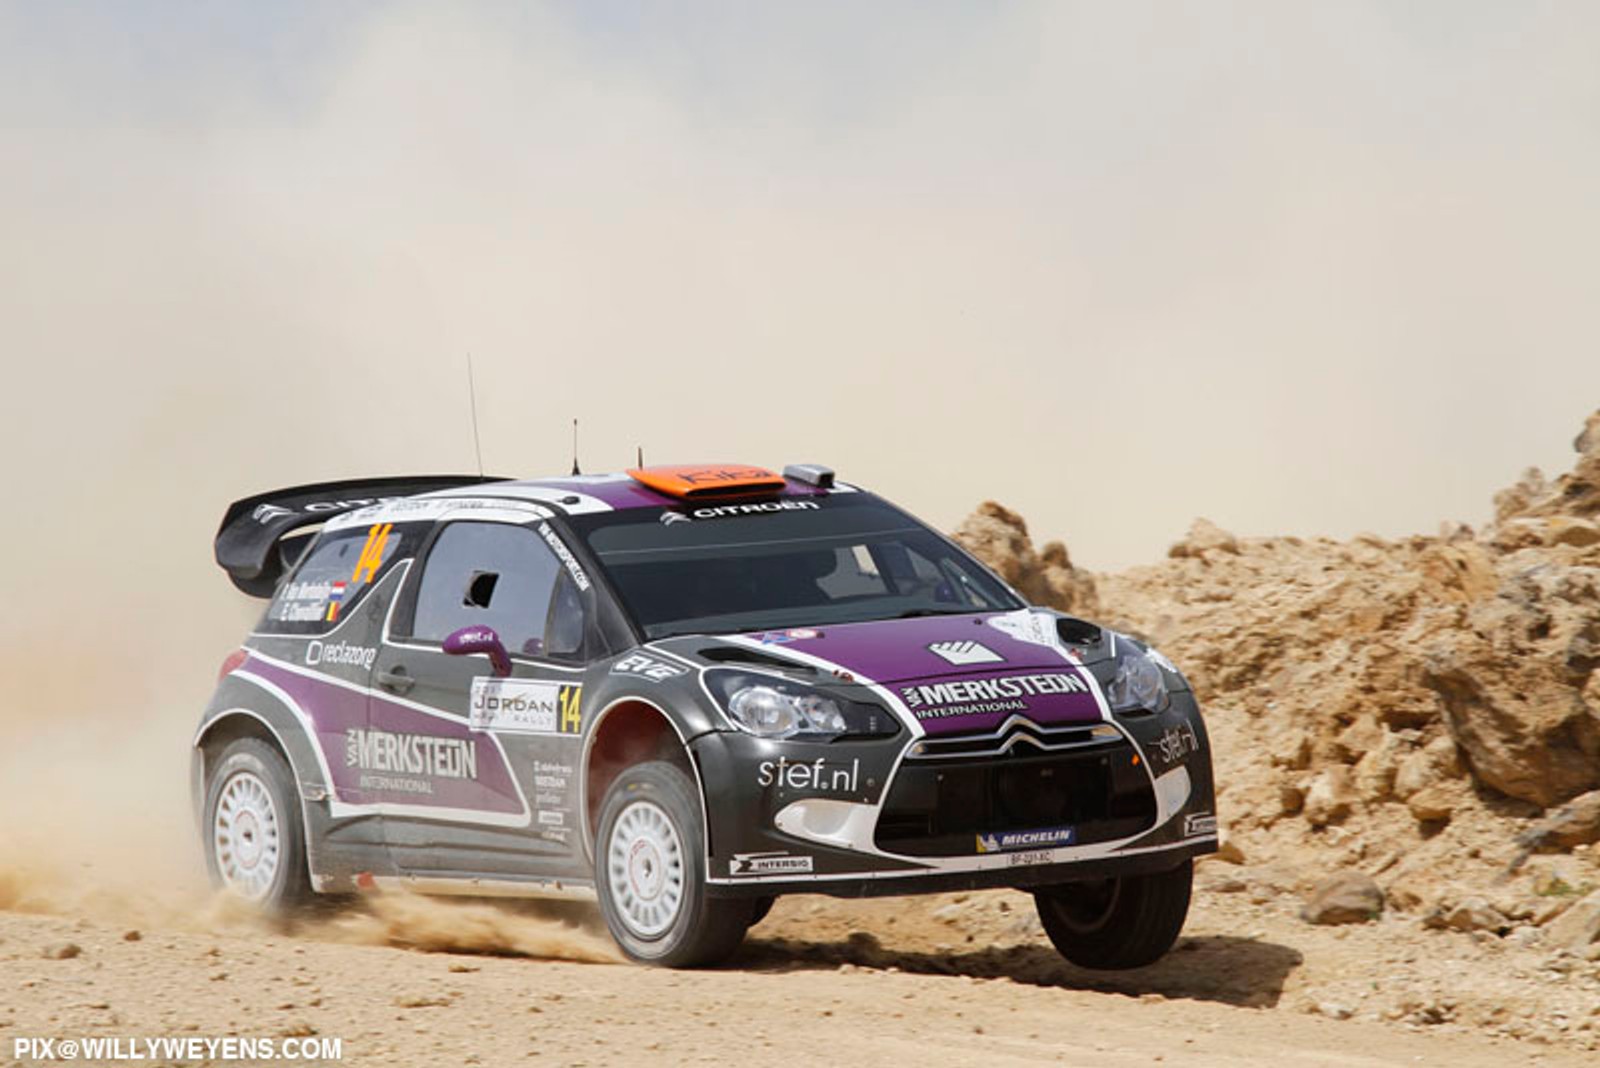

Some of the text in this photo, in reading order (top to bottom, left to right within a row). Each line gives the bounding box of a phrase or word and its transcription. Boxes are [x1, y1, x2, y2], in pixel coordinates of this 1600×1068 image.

[351, 522, 394, 584] 14
[474, 684, 582, 734] JORDAN 14
[915, 699, 1028, 720] INTERNATIONAL
[347, 728, 360, 767] VAN
[359, 774, 433, 794] INTERNATIONAL
[757, 756, 860, 791] stef.nl
[1001, 829, 1071, 846] MICHELIN
